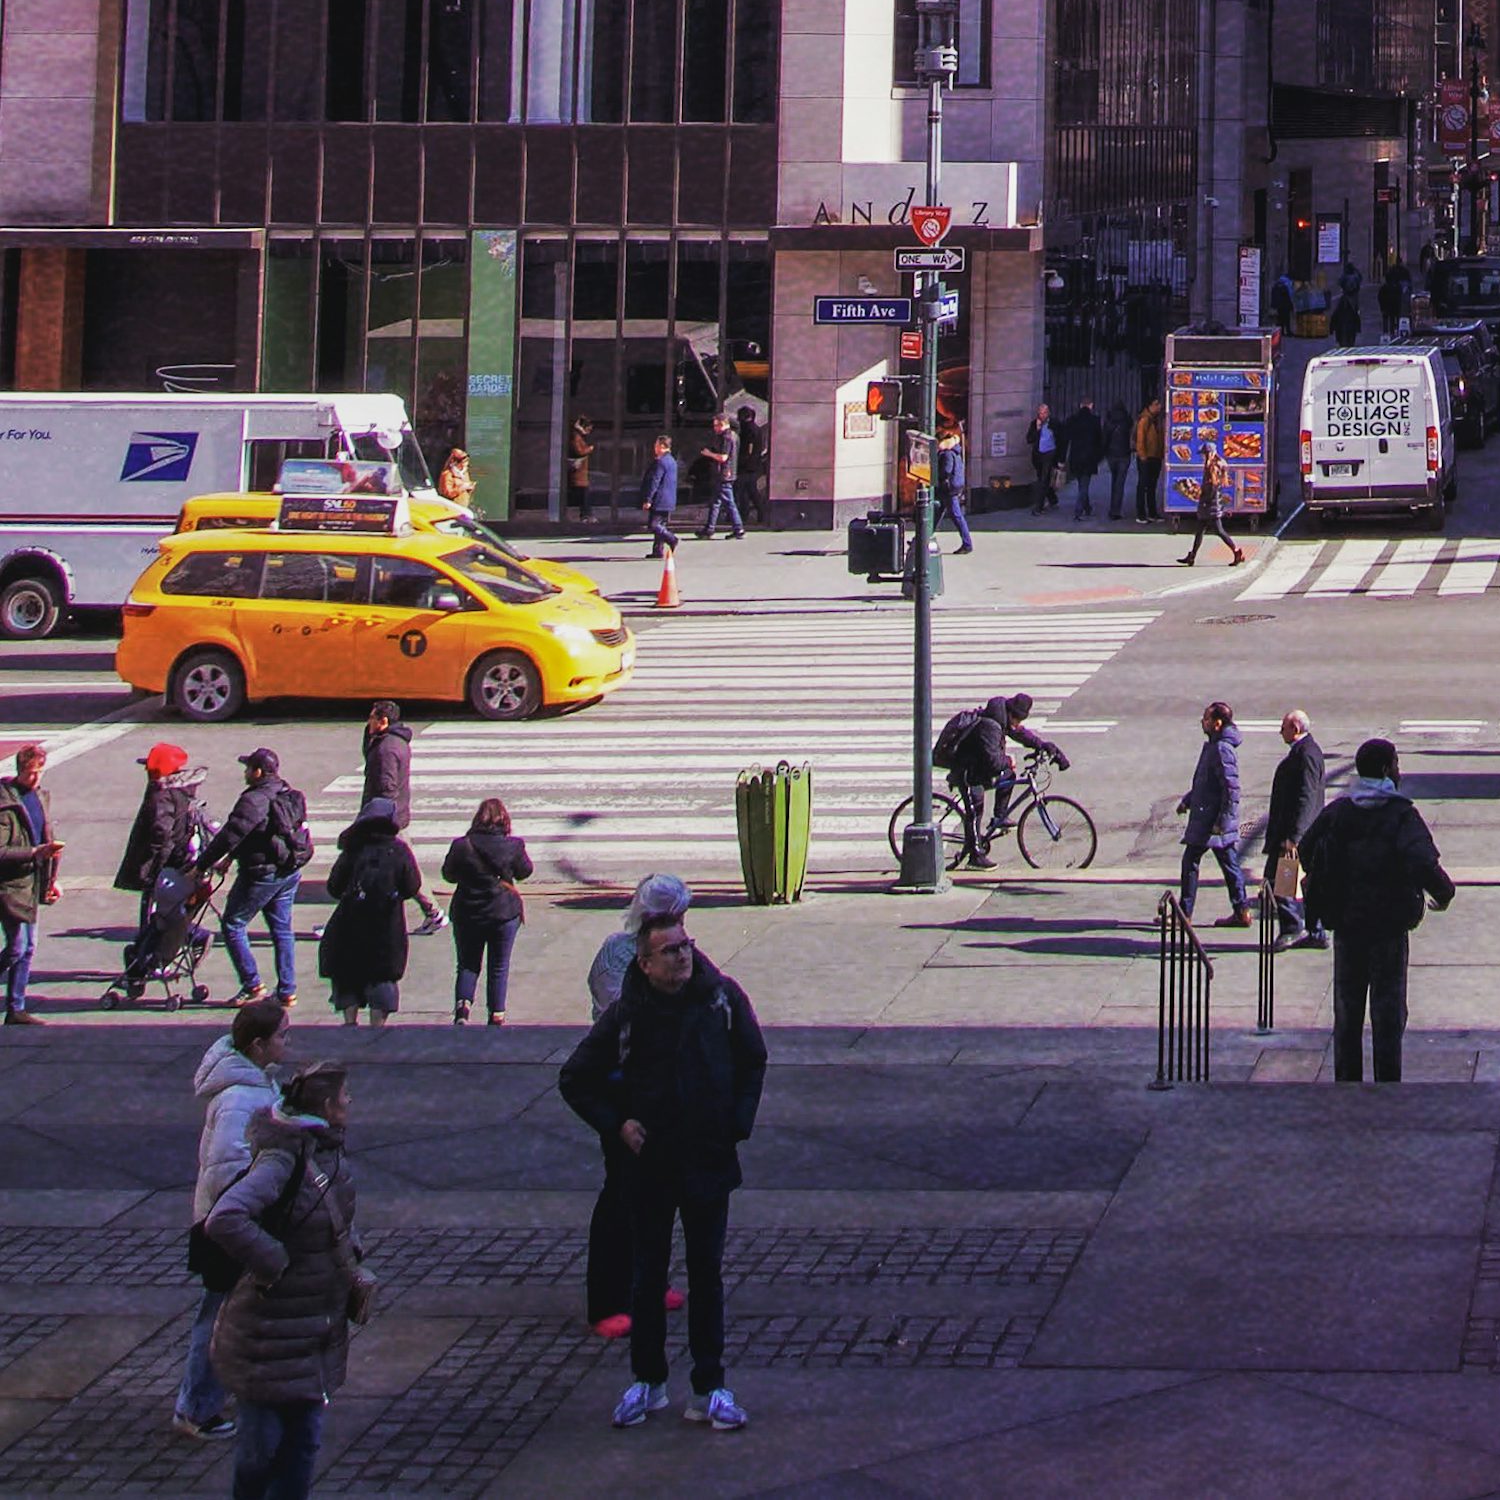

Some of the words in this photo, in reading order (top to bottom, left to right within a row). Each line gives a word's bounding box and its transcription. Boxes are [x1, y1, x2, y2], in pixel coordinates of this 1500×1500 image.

[814, 187, 990, 225] ANdZ
[901, 254, 921, 264] ONE
[932, 254, 954, 264] WAY
[831, 303, 866, 318] Fifth
[869, 303, 896, 318] Ave
[468, 374, 512, 384] SECRET
[468, 384, 512, 394] GARDEN
[1327, 388, 1411, 406] INTERIOR
[1327, 404, 1410, 421] FOLIAGE
[7, 429, 26, 440] For
[1327, 421, 1402, 437] DESIGN
